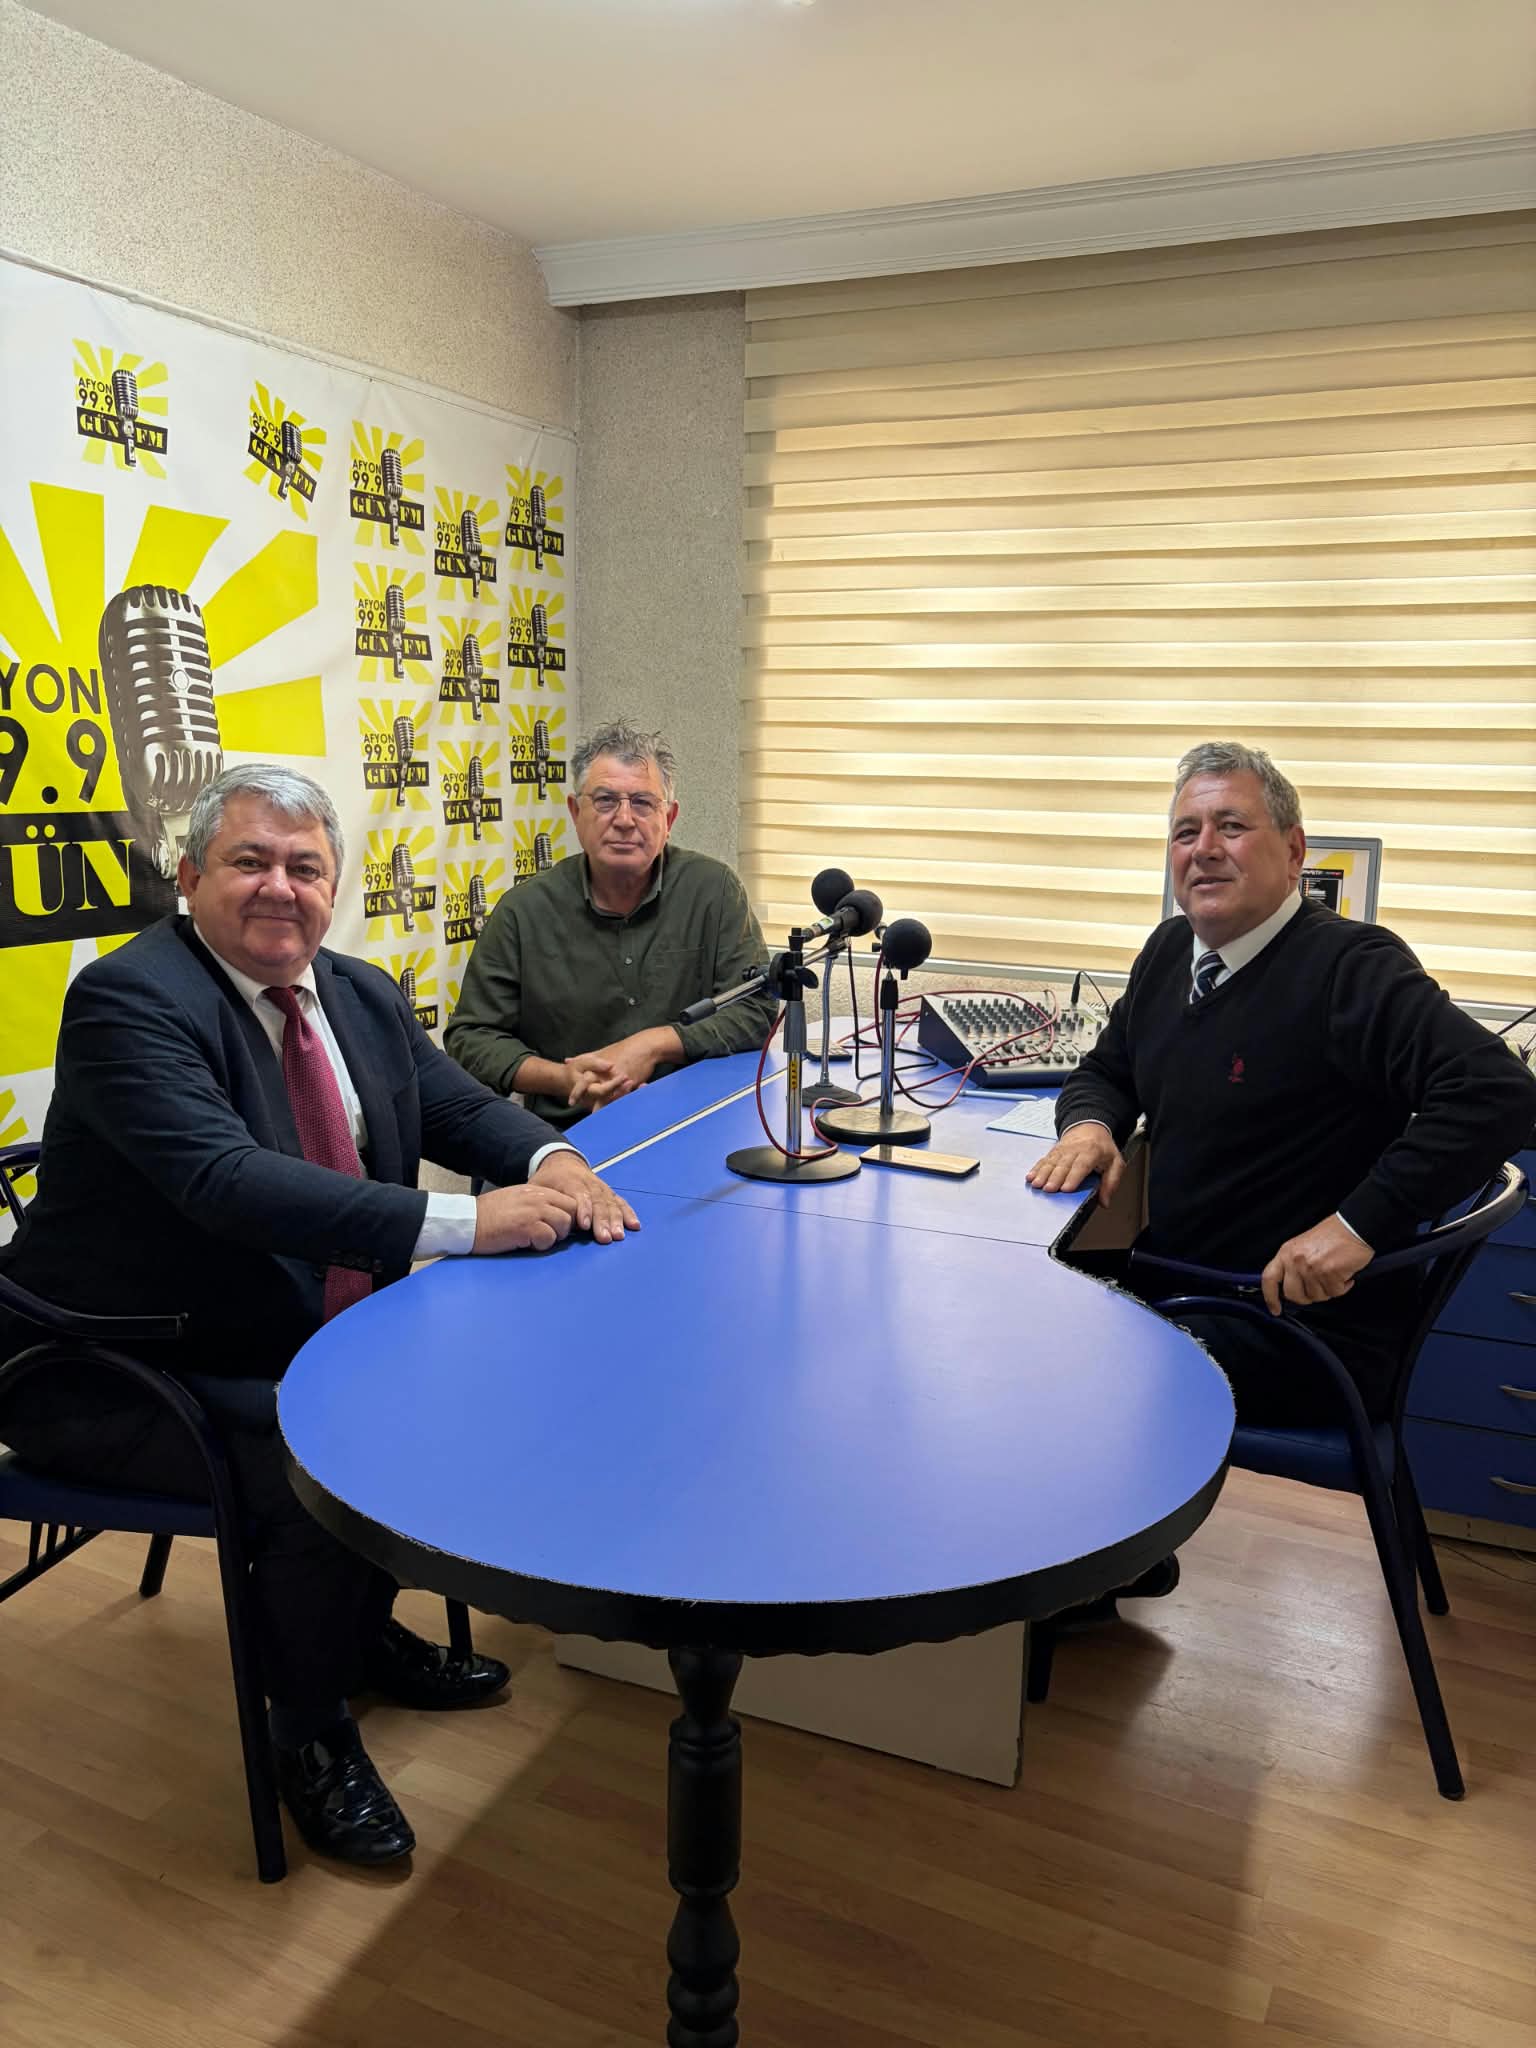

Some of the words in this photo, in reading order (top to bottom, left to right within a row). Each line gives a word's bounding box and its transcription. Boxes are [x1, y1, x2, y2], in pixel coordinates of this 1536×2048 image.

[78, 377, 112, 394] AFYON
[78, 388, 113, 412] 99.9
[79, 412, 120, 438] GÜN
[135, 426, 164, 449] FM
[253, 420, 281, 448] 99.9
[353, 459, 382, 474] AFYON
[353, 470, 382, 493] 99.9
[352, 495, 387, 518] GÜN
[400, 505, 422, 525] FM
[437, 532, 461, 551] 99.9
[436, 554, 467, 574] GÜN
[358, 599, 386, 611] AFYON
[358, 609, 386, 629] 99.9
[358, 632, 390, 653] GÜN
[403, 639, 428, 655] FM
[510, 626, 532, 643] 99.9
[0, 662, 102, 714] YON
[364, 733, 395, 743] AFYON
[0, 716, 107, 805] 9.9
[364, 744, 395, 761] 99.9
[512, 744, 534, 760] 99.9
[366, 764, 400, 784] GÜN
[407, 767, 427, 782] FM
[444, 783, 467, 799] 99.9
[482, 803, 499, 818] FM
[0, 824, 136, 916] ÜN
[365, 862, 392, 874] AFYON
[516, 859, 535, 873] 99.9
[365, 872, 392, 890] 99.9
[413, 890, 434, 908] FM
[446, 902, 469, 919] 99.9
